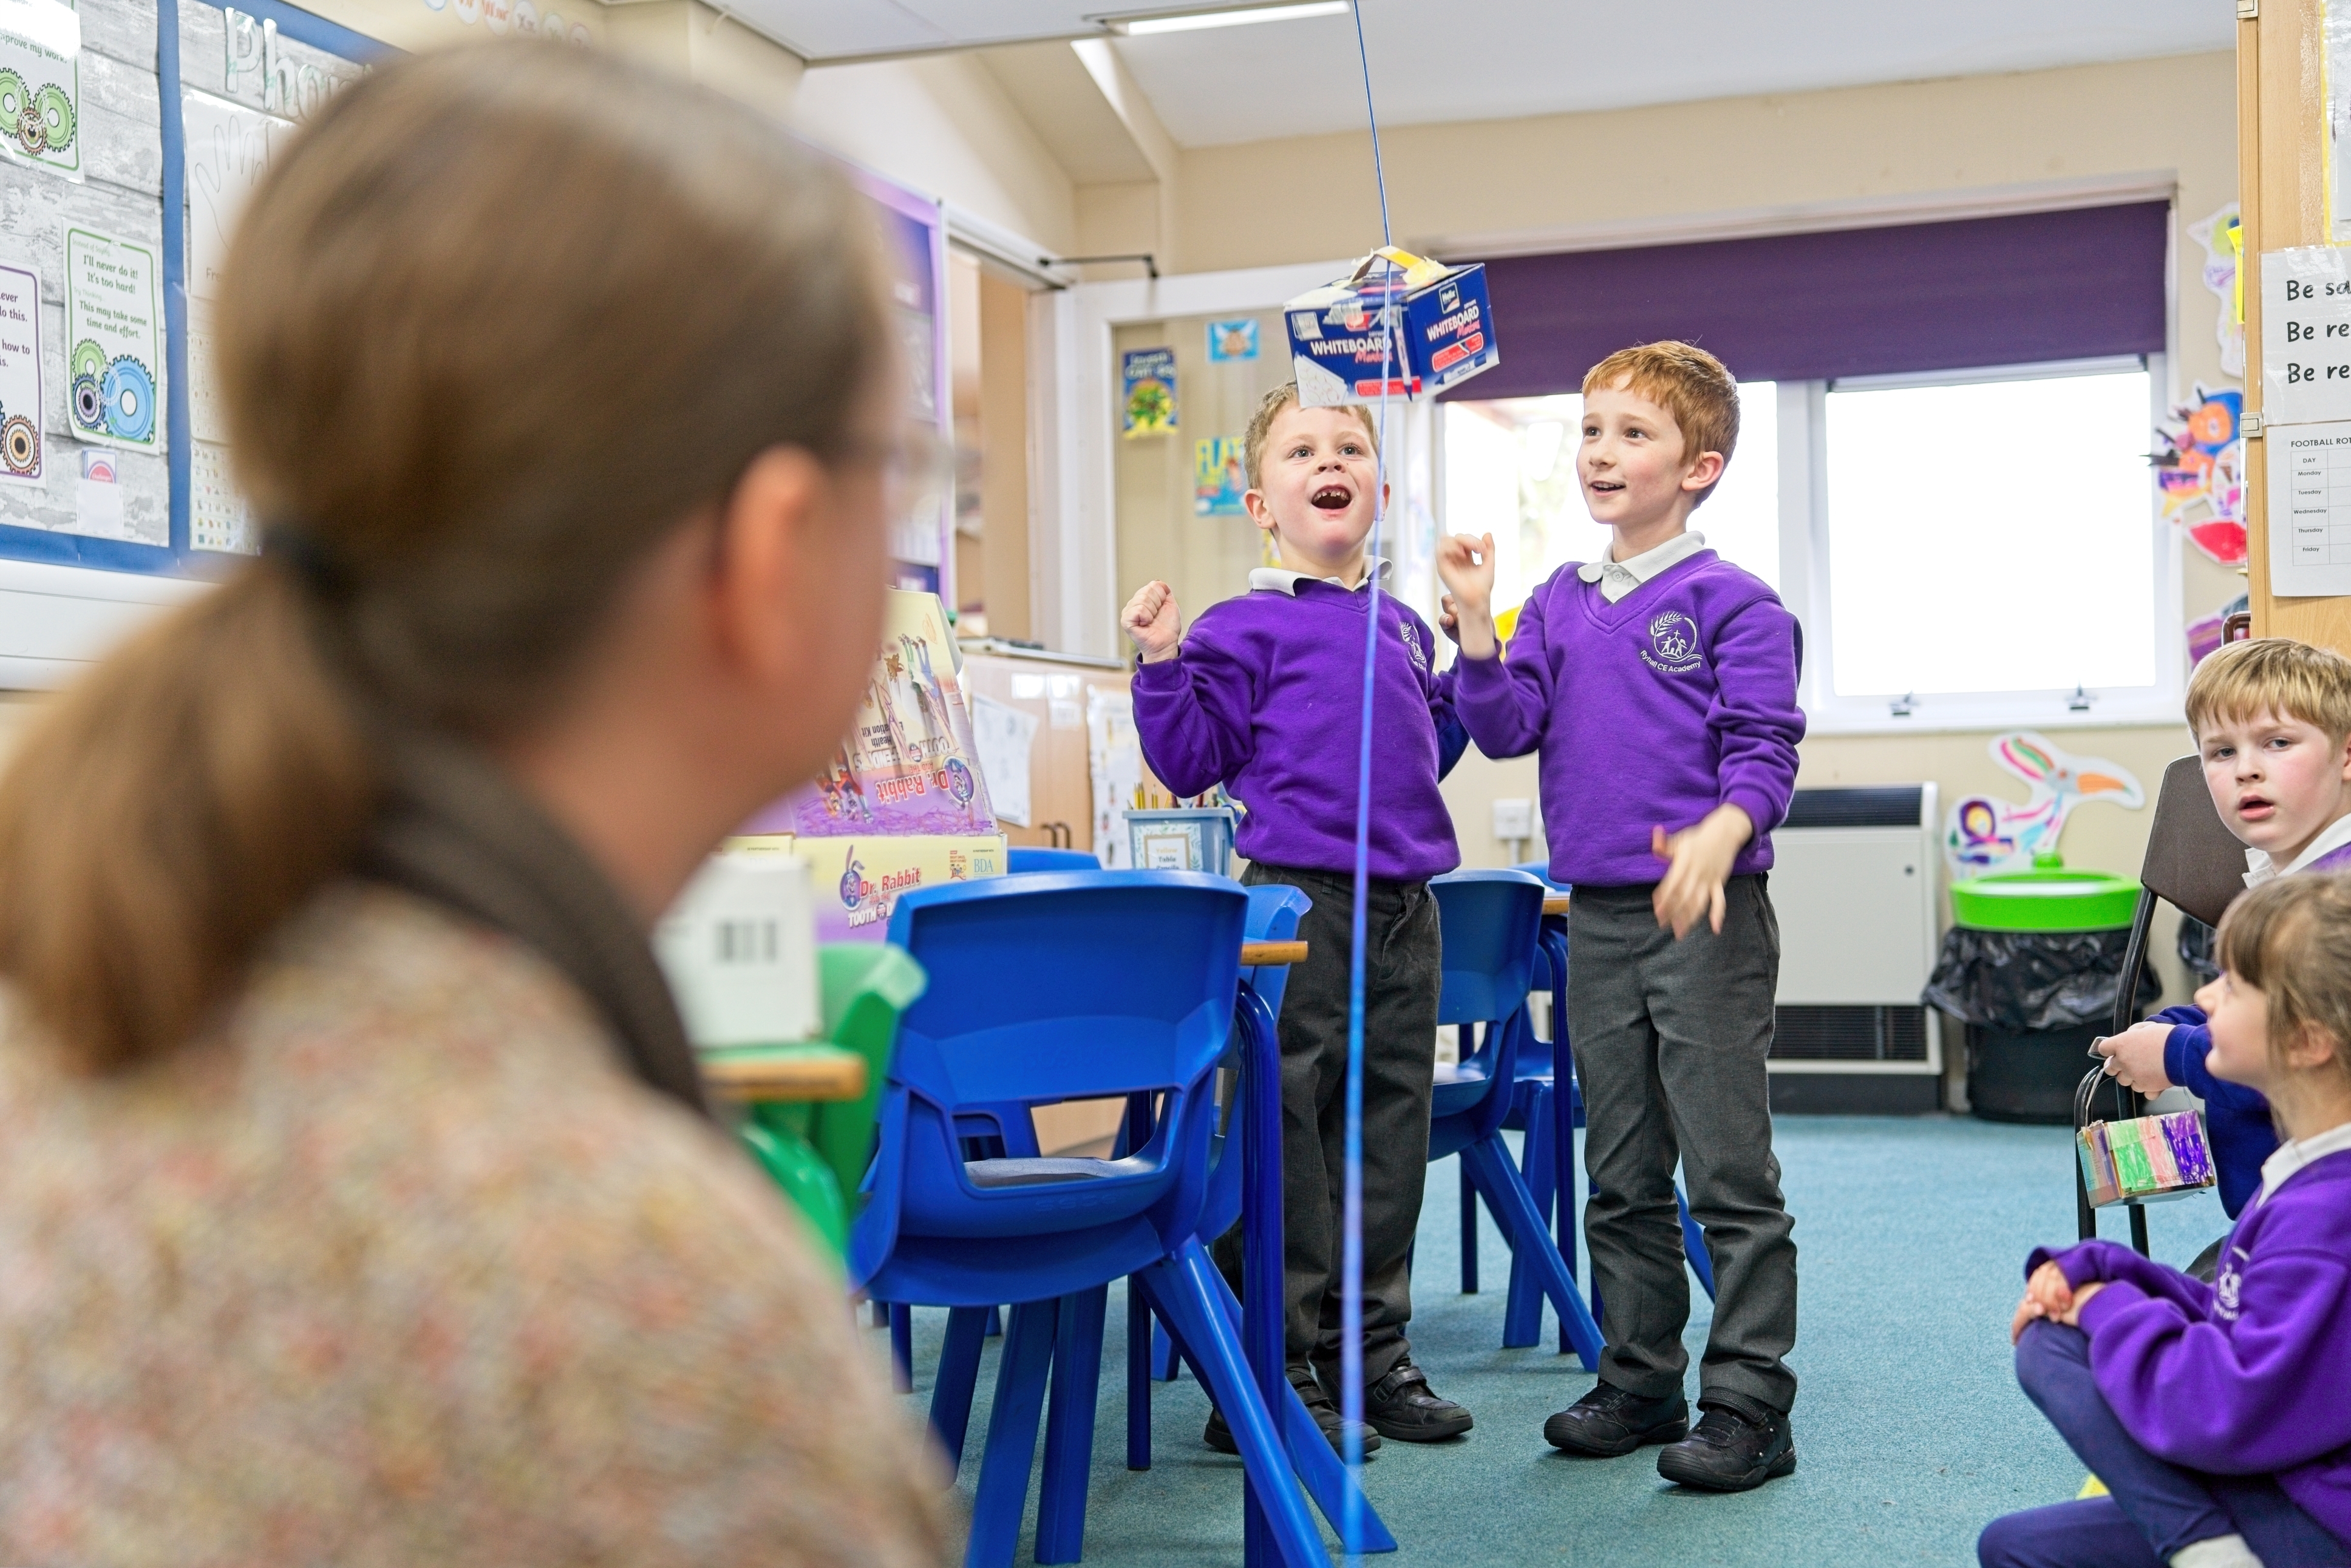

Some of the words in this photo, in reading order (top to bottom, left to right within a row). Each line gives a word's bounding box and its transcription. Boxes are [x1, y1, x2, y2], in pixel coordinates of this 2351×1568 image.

[30, 44, 42, 57] my
[84, 254, 94, 266] I'll
[97, 260, 116, 273] never
[119, 265, 128, 276] do
[87, 272, 99, 284] It's
[101, 277, 114, 288] too
[116, 279, 135, 294] hard!
[2287, 280, 2313, 301] Be
[0, 292, 18, 302] ever
[10, 308, 27, 322] this.
[80, 300, 94, 313] This
[97, 307, 111, 320] may
[114, 310, 128, 322] take
[130, 316, 147, 327] some
[1427, 305, 1479, 342] WHITEBOARD
[87, 316, 102, 330] time
[104, 323, 117, 333] and
[120, 325, 141, 339] effort.
[2287, 321, 2314, 342] Be
[2327, 323, 2349, 338] re
[2, 339, 19, 353] how
[22, 344, 30, 355] to
[2287, 362, 2315, 384] Be
[2327, 365, 2350, 379] re
[2291, 438, 2333, 447] FOOTBALL
[1640, 650, 1658, 668] Ryhall
[1657, 663, 1669, 671] CE
[1668, 661, 1701, 673] Academy
[861, 727, 872, 738] Kit
[871, 735, 893, 748] Health
[922, 761, 933, 771] AND
[875, 774, 926, 804] Rabbit
[927, 769, 950, 791] Dr.
[973, 858, 994, 873] BDA
[860, 880, 877, 898] Dr.
[881, 866, 920, 892] Rabbit
[869, 896, 879, 904] AND
[848, 906, 877, 928] TOOTH
